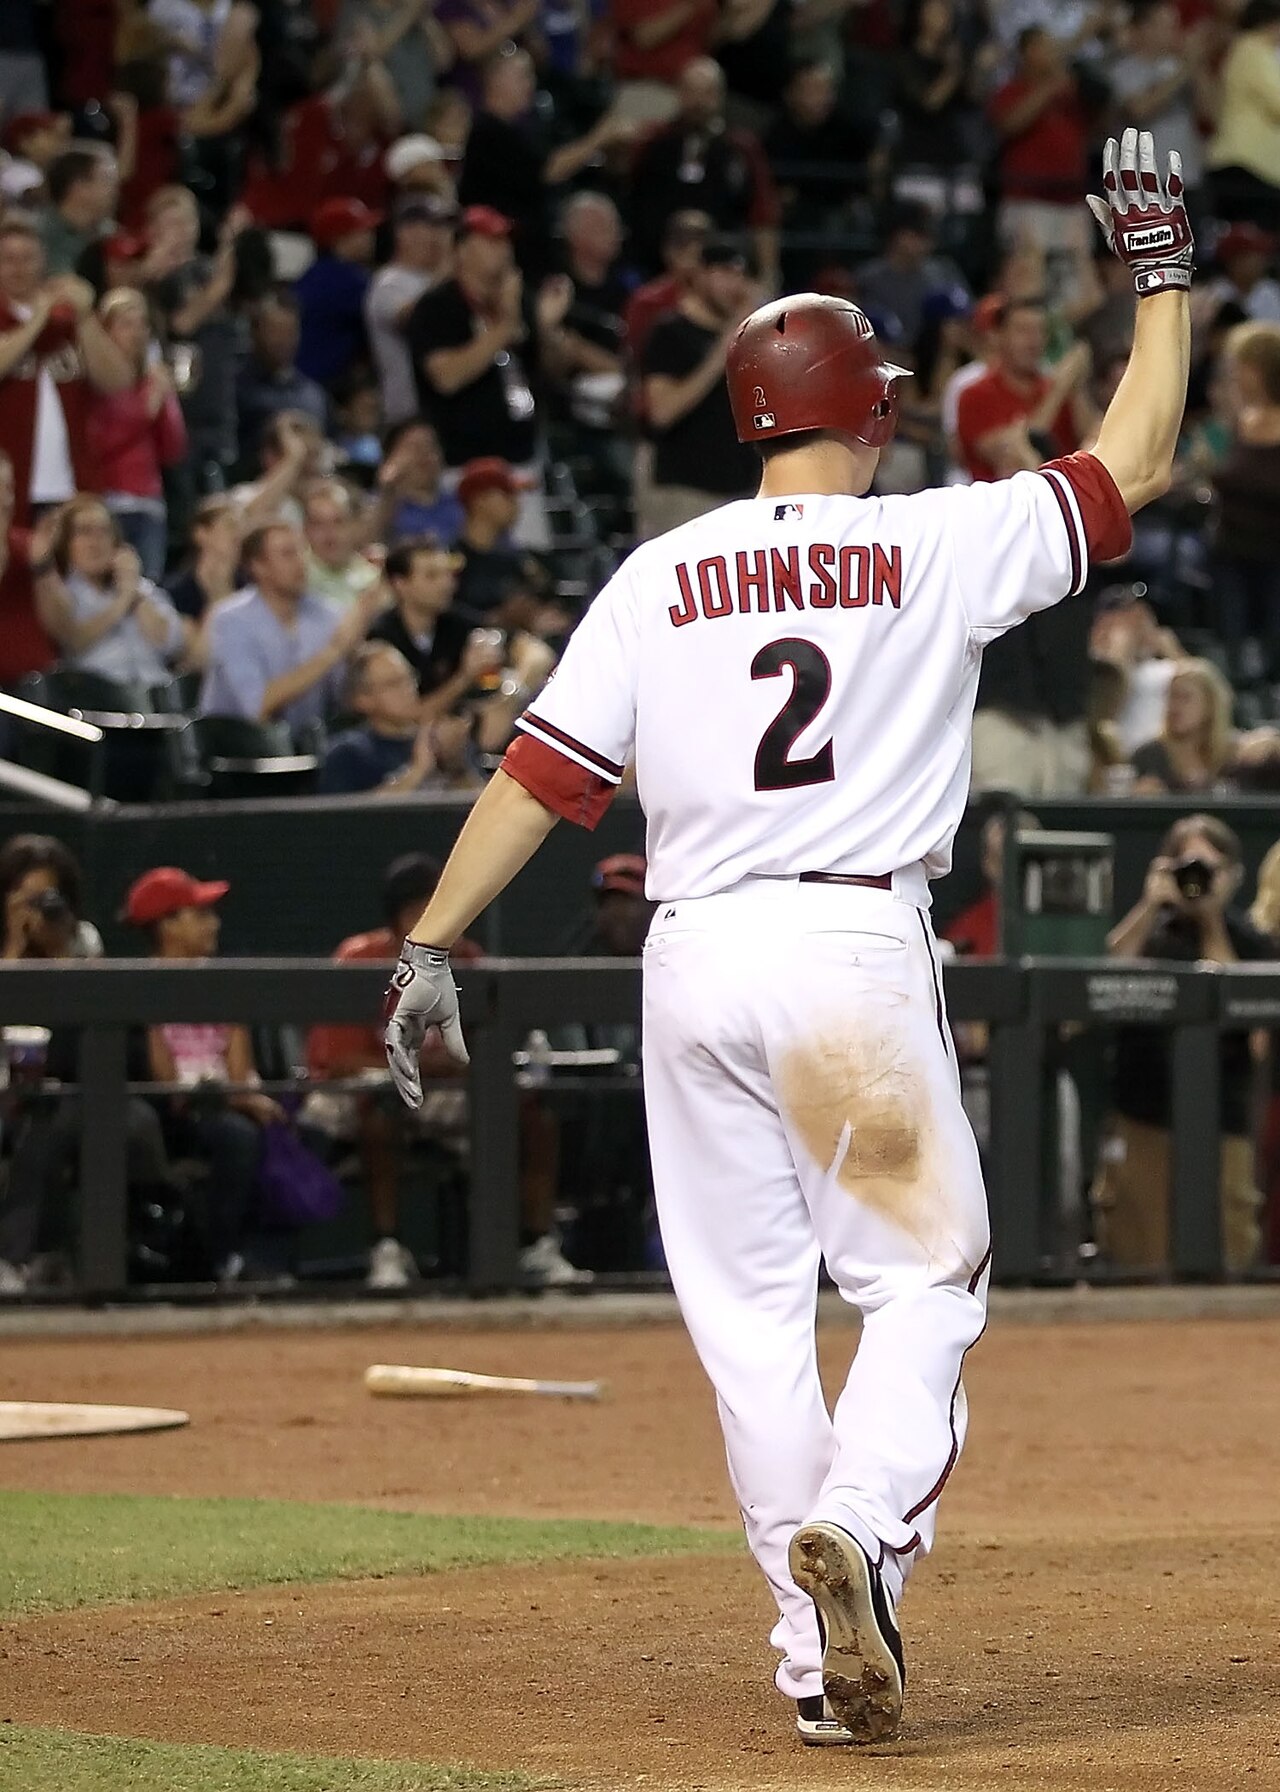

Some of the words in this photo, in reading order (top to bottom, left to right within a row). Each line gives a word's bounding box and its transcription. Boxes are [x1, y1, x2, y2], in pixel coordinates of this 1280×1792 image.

[1127, 229, 1171, 249] Franklin
[752, 385, 767, 408] 2
[668, 543, 902, 628] JOHNSON
[750, 638, 835, 792] 2
